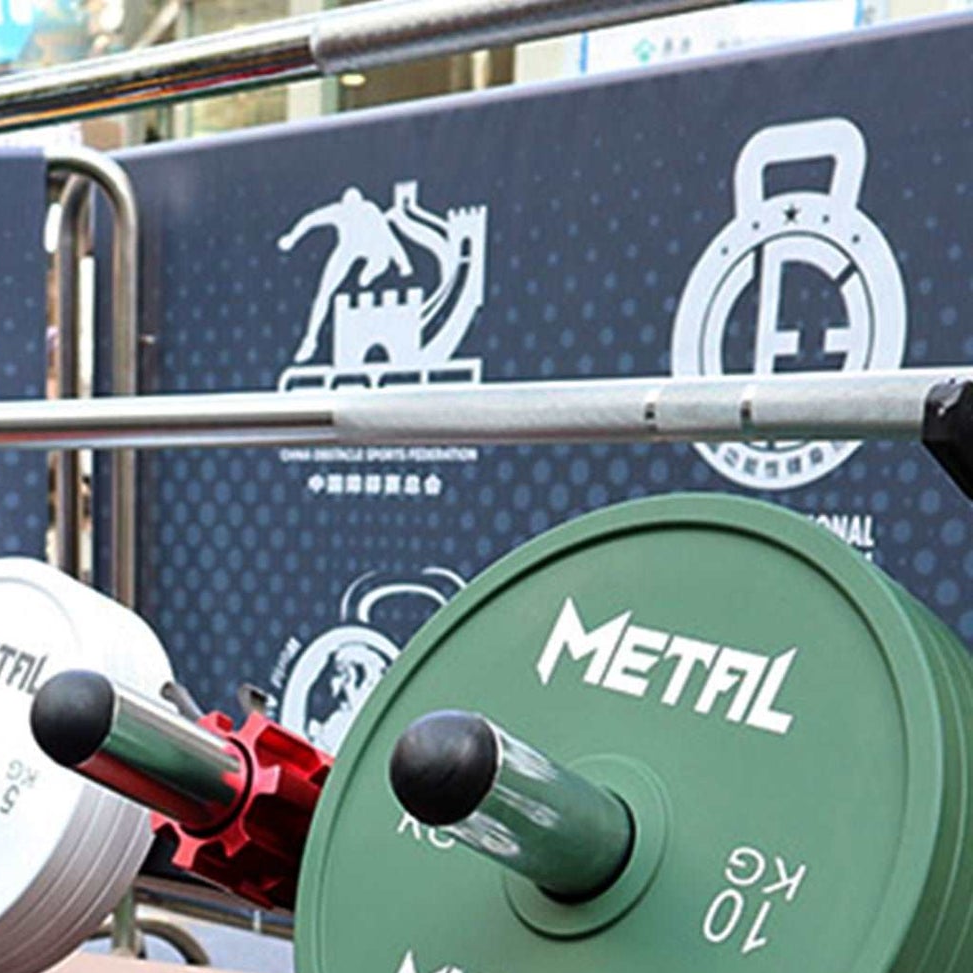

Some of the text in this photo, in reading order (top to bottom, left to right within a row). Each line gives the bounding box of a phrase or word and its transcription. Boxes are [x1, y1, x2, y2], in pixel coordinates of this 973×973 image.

[536, 598, 798, 735] METAL
[724, 846, 807, 903] KG
[701, 888, 773, 955] 10
